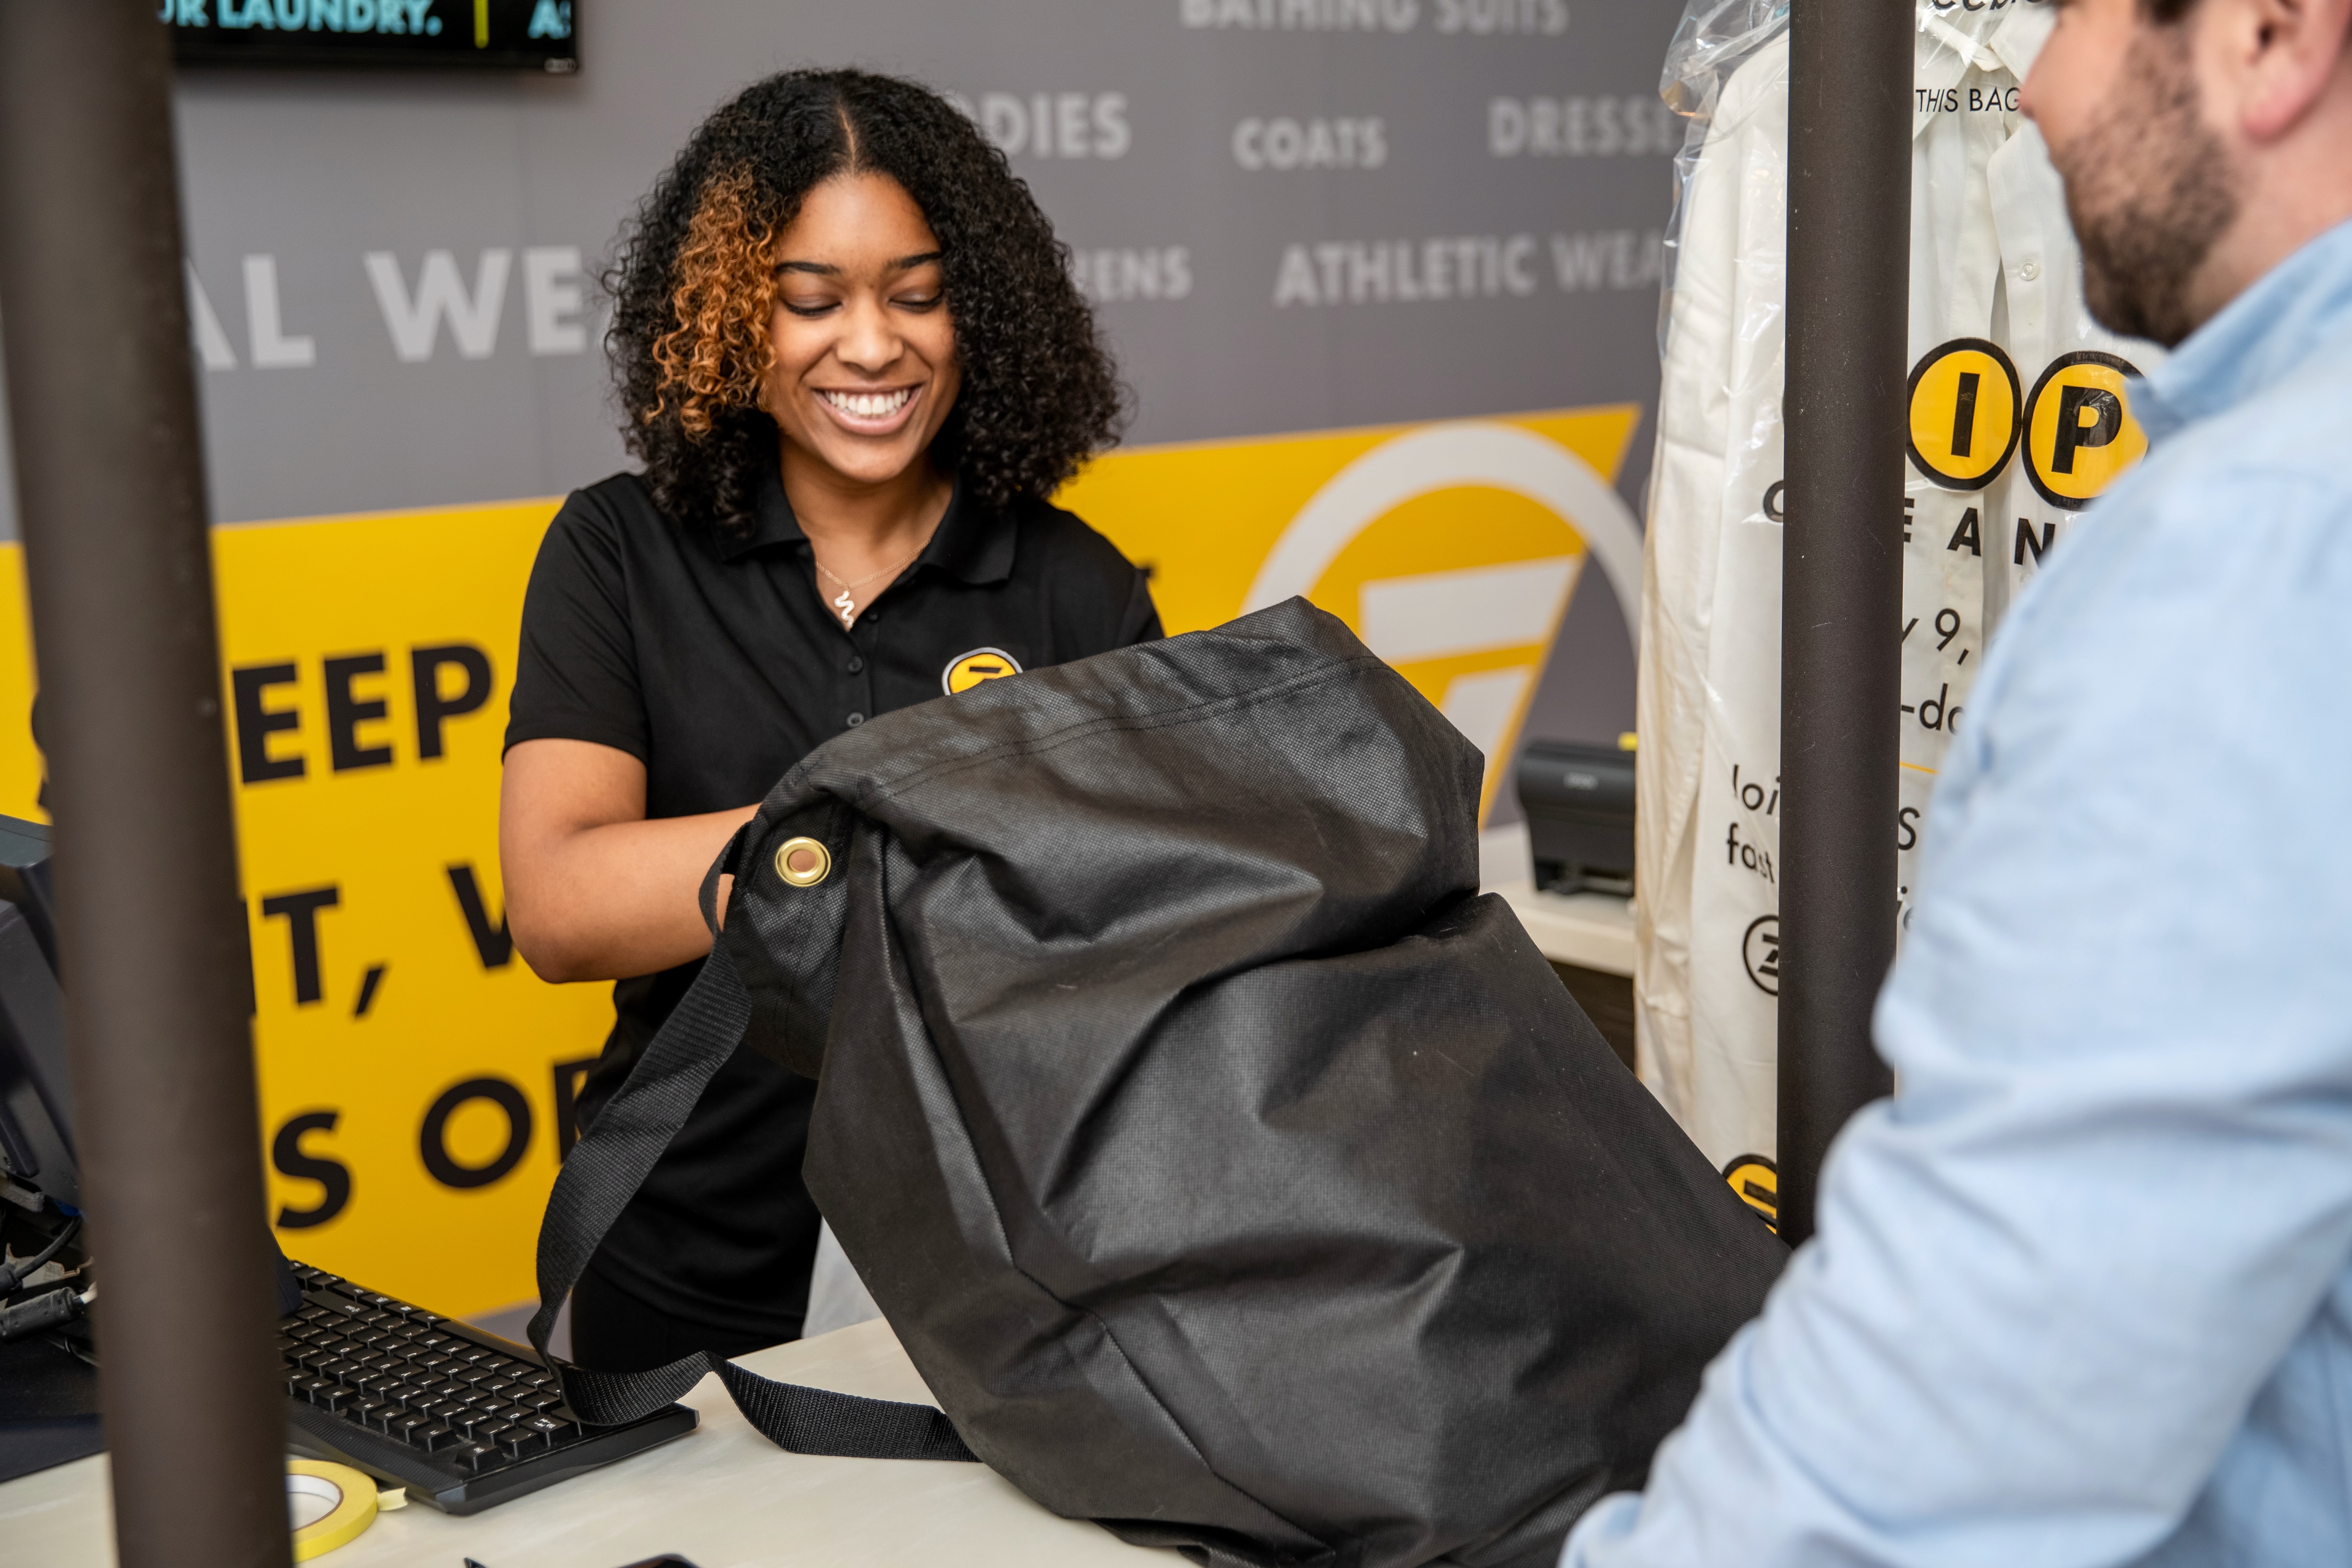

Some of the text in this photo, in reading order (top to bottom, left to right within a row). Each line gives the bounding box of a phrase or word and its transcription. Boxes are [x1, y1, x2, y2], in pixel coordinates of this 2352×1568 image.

[217, 0, 443, 36] LAUNDRY.
[1916, 87, 2021, 112] THIS BAG
[1232, 117, 1388, 170] COATS
[1273, 234, 1537, 307] ATHLETIC
